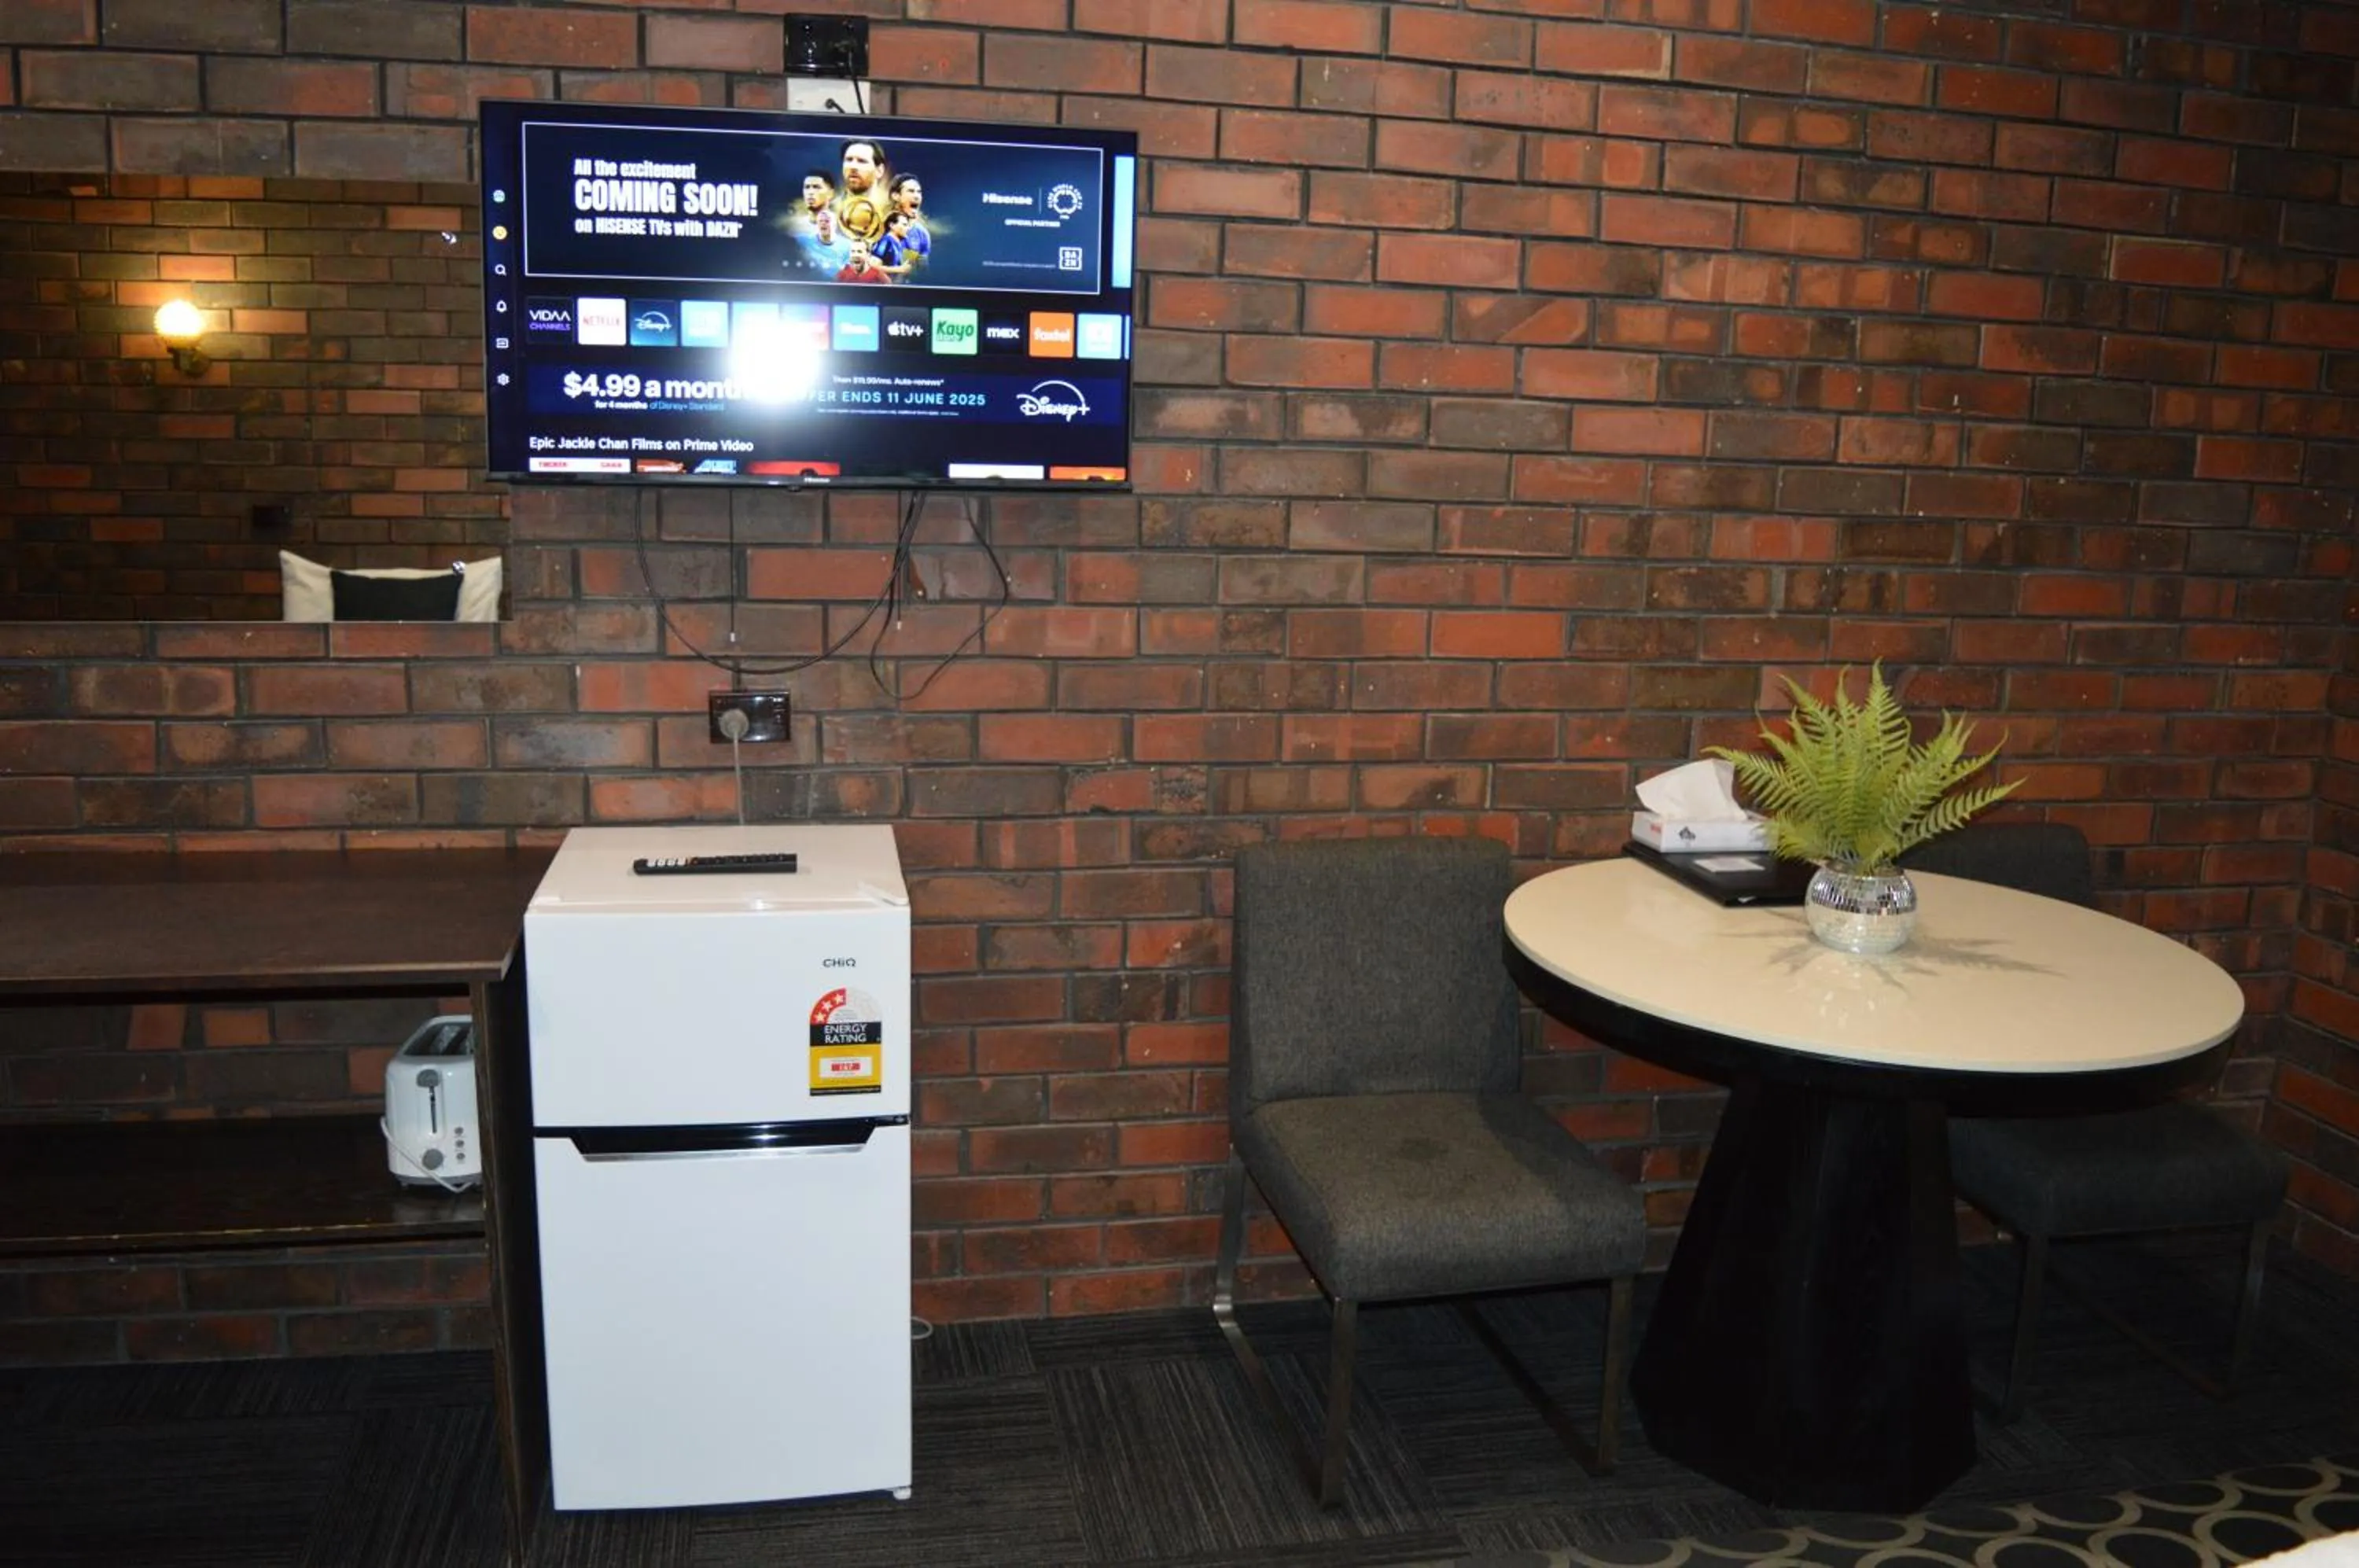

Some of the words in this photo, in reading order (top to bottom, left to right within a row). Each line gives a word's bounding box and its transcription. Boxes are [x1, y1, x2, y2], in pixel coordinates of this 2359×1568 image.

[574, 159, 591, 175] All
[594, 160, 617, 177] the
[620, 160, 696, 179] excitement
[575, 179, 676, 213] COMING
[683, 182, 758, 215] SOON!
[575, 219, 592, 233] on
[595, 217, 646, 234] HISENSE
[649, 219, 672, 236] TVs
[673, 219, 704, 237] with
[529, 310, 571, 322] VIDAA
[583, 317, 620, 326] NETFLIX
[529, 322, 570, 331] CHANNELS
[937, 320, 974, 341] Kayo
[987, 327, 1019, 338] max
[564, 371, 641, 398] $4.99
[644, 381, 661, 398] a
[842, 391, 881, 403] ENDS
[888, 392, 899, 403] 11
[904, 392, 944, 404] JUNE
[949, 394, 986, 406] 2025
[1016, 383, 1090, 421] Disney+
[529, 436, 555, 451] Epic
[558, 437, 595, 450] Jackie
[598, 437, 629, 450] Chan
[631, 438, 662, 451] Films
[665, 440, 681, 451] on
[683, 439, 717, 451] Prime
[720, 440, 753, 451] Video
[824, 1024, 867, 1034] ENERGY
[824, 1033, 867, 1043] RATING
